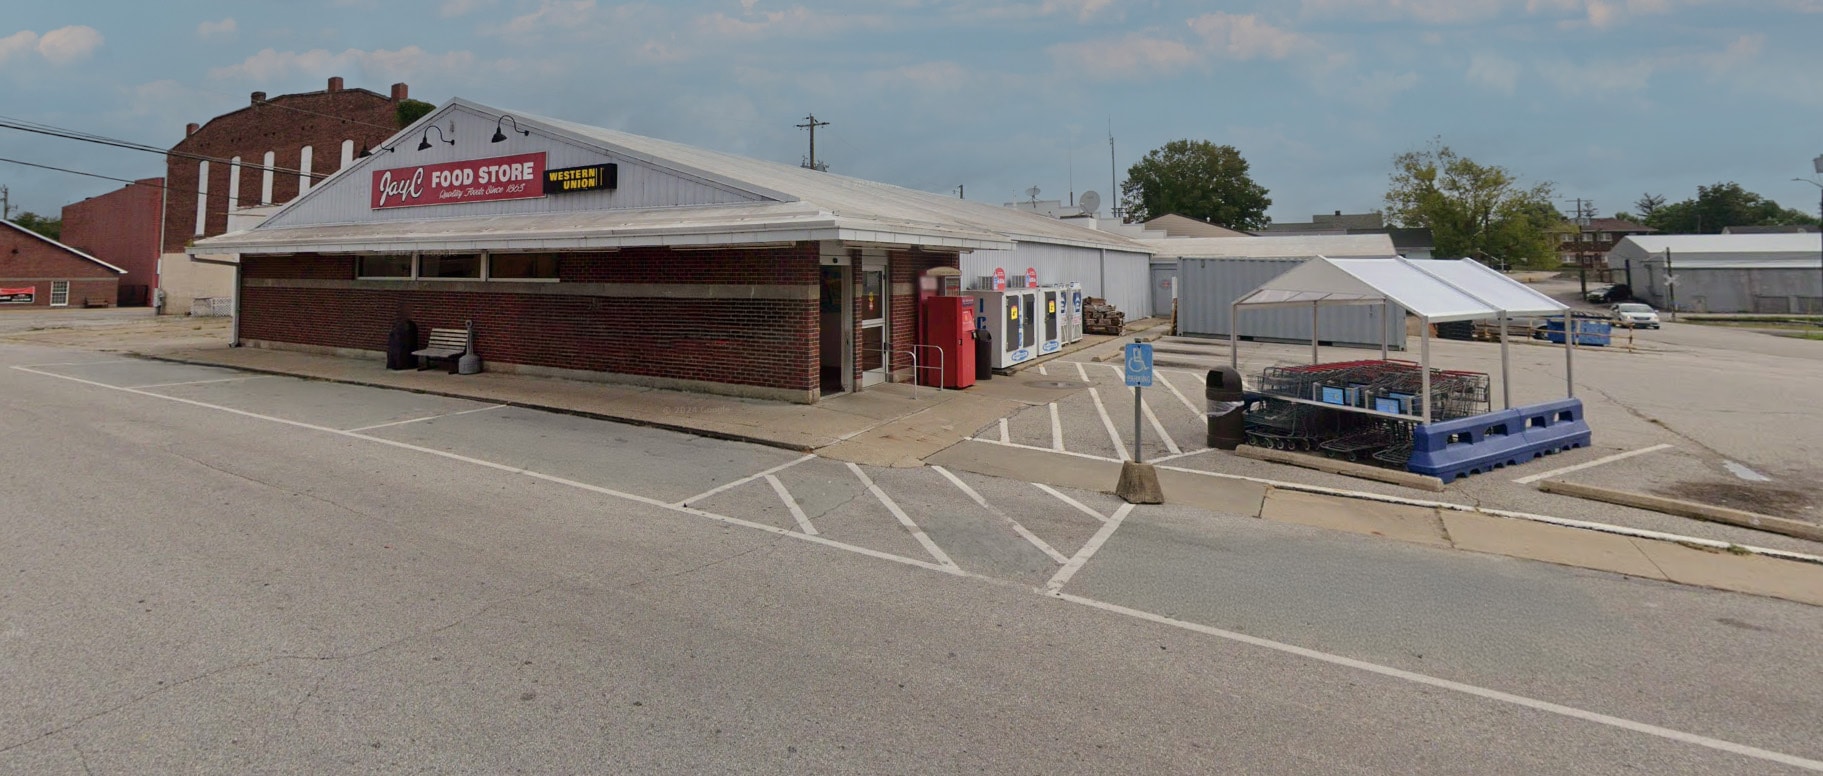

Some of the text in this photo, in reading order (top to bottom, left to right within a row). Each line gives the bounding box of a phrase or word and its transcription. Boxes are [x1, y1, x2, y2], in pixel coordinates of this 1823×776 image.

[549, 168, 596, 181] WESTERN
[379, 162, 534, 206] JayC FOOD STORE
[486, 185, 504, 195] Since
[563, 177, 596, 190] UNION
[976, 298, 987, 329] IC
